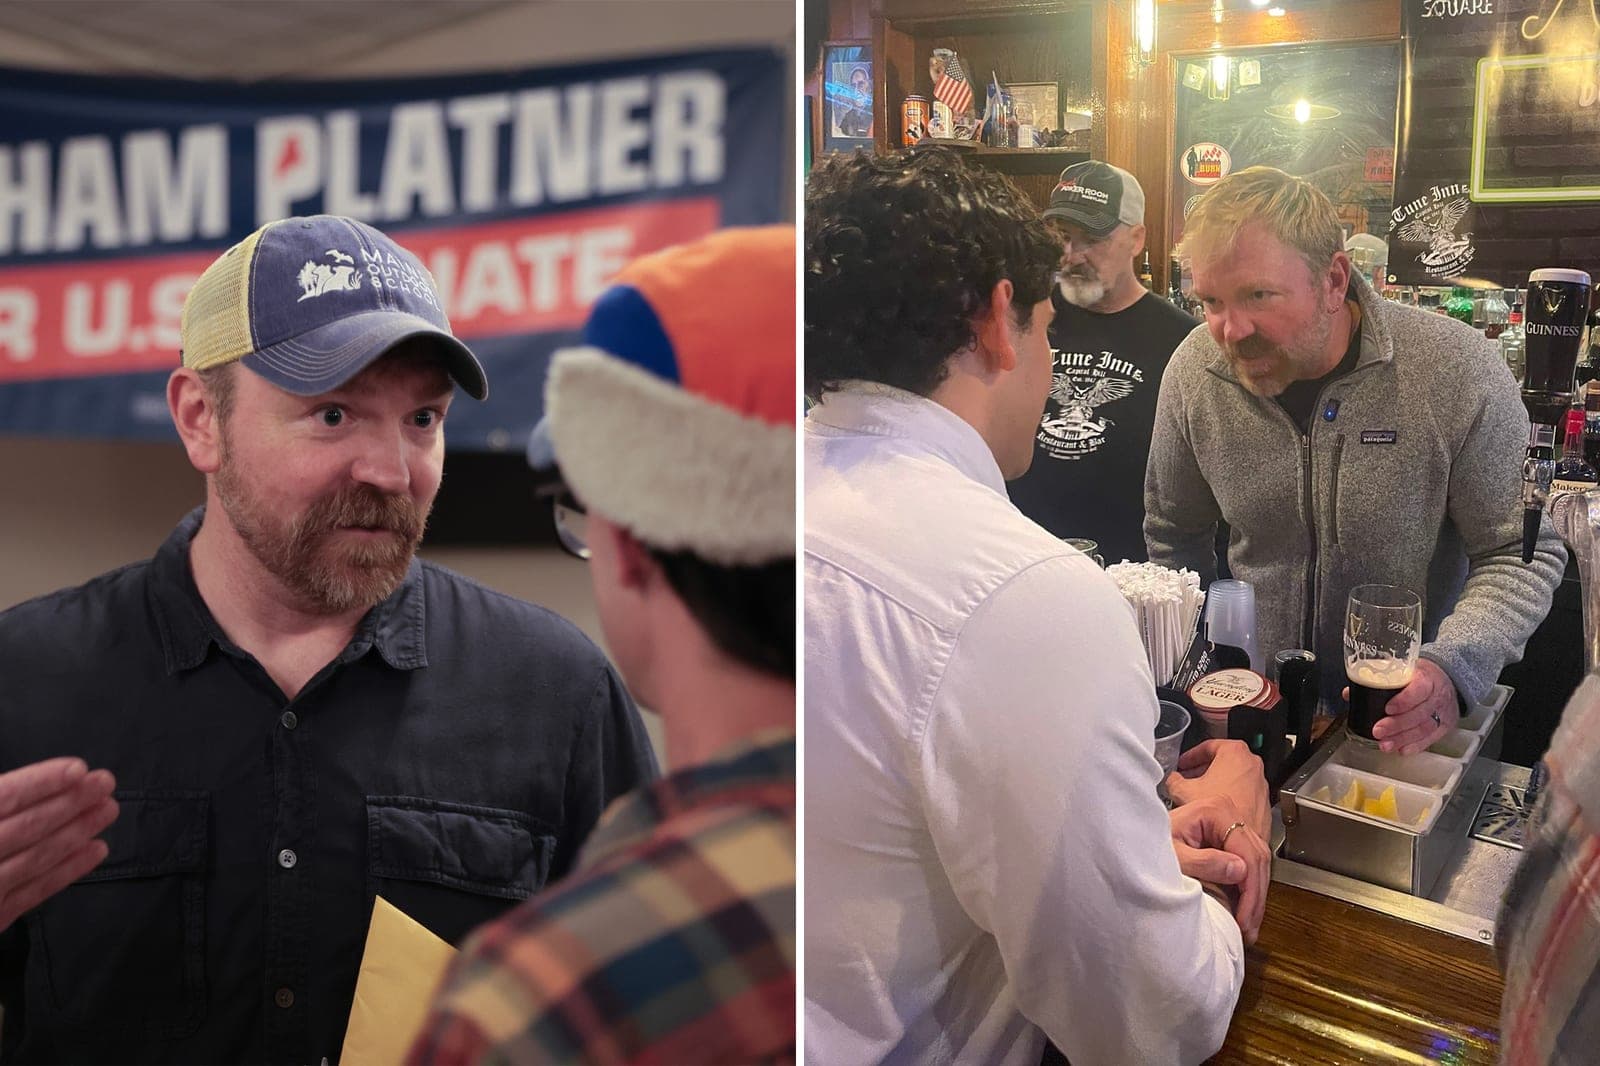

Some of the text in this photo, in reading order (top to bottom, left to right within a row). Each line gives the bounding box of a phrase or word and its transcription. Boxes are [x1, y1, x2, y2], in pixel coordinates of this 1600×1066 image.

[1421, 0, 1493, 19] SQUARE
[256, 72, 727, 224] PLATNER
[1085, 188, 1109, 200] ROOM
[1392, 183, 1460, 222] Tune Inn
[371, 276, 440, 312] SCHOOL
[1527, 321, 1580, 337] GUINNESS
[1096, 351, 1135, 375] Inn
[1037, 431, 1077, 449] Restaurant
[1088, 437, 1106, 448] Bar
[1196, 687, 1245, 702] LAGER
